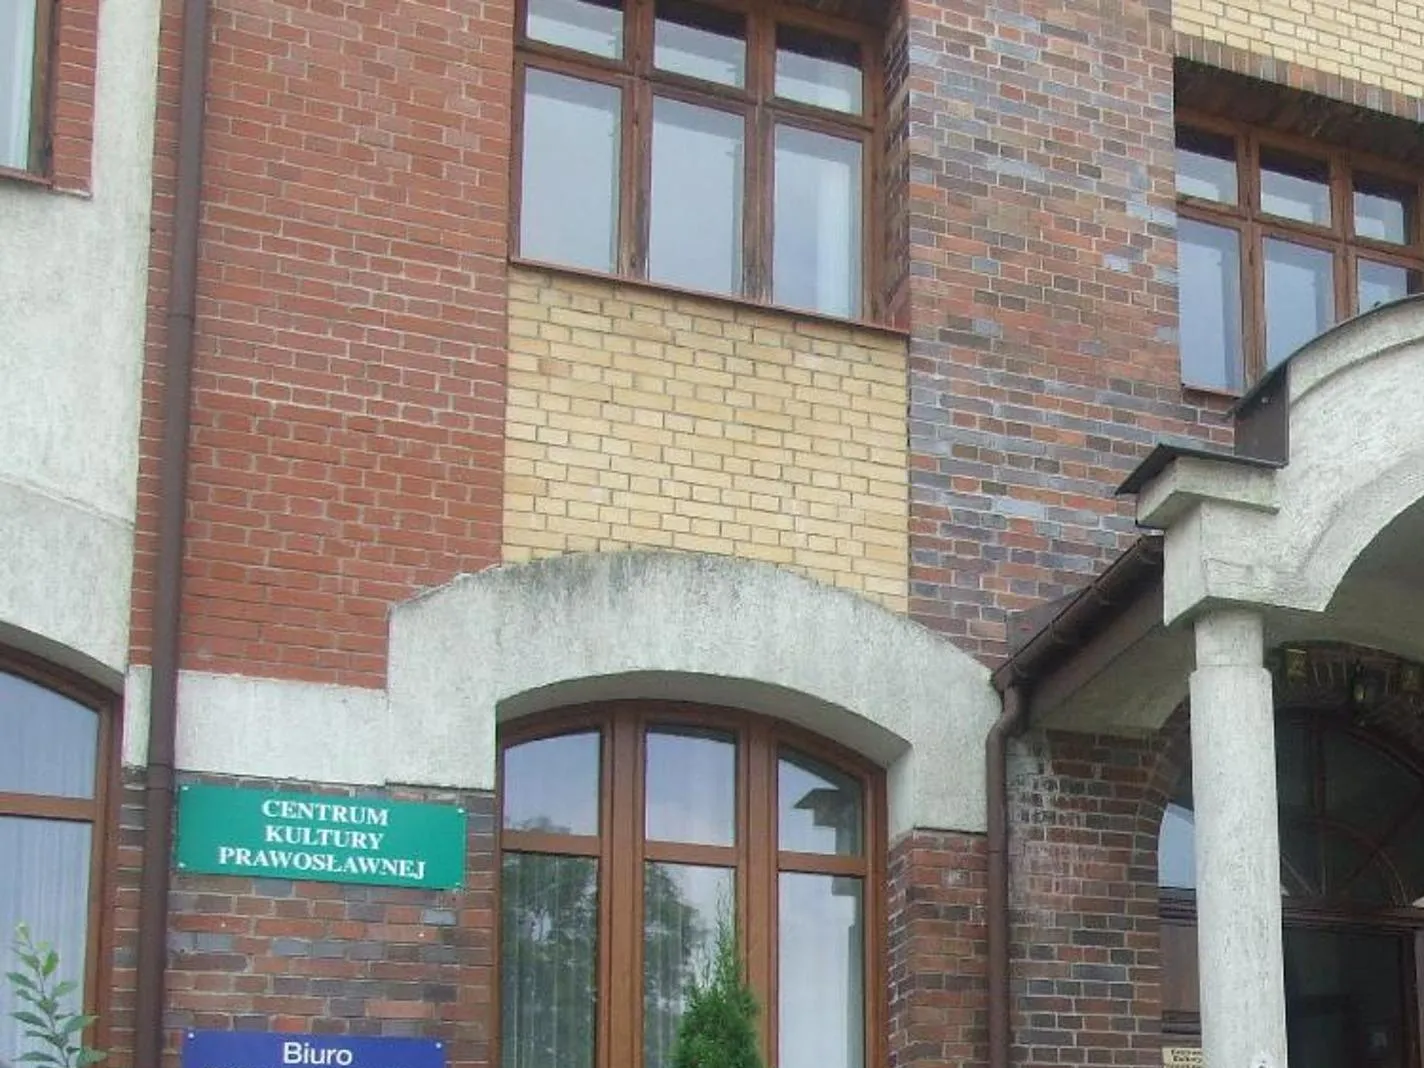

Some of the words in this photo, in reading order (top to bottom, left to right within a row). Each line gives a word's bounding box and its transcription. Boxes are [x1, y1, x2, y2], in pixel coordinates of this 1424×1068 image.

[261, 799, 389, 826] CENTRUM
[265, 824, 385, 850] KULTURY
[217, 846, 427, 880] PRAWOSŁAWNEJ
[283, 1041, 353, 1066] Biuro
